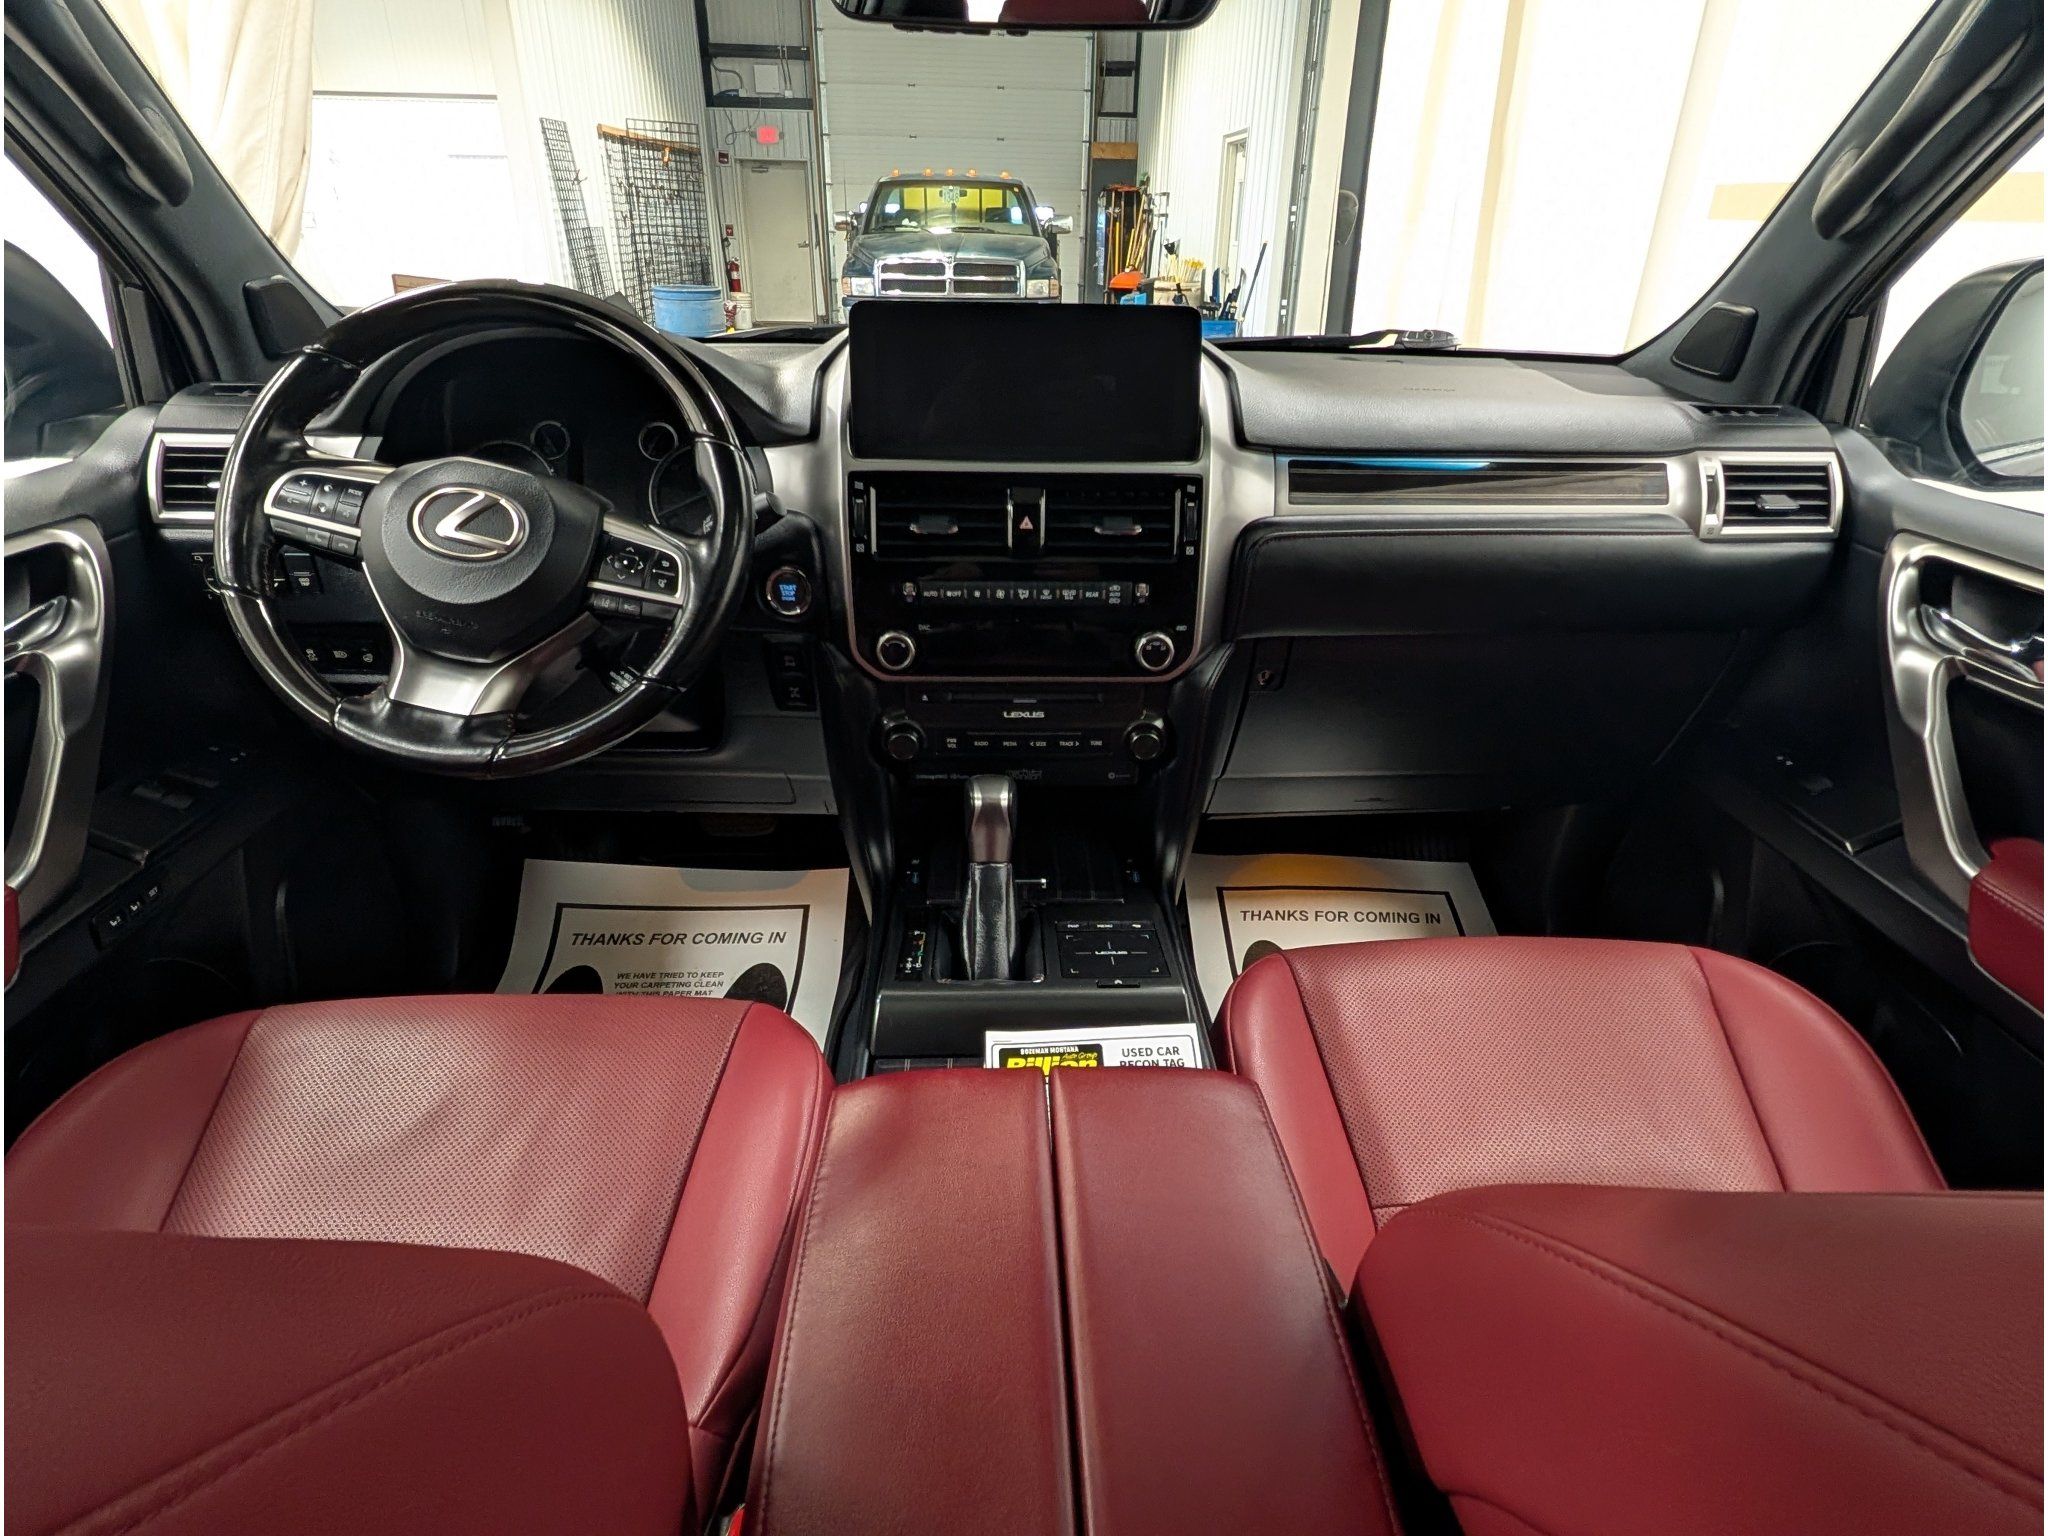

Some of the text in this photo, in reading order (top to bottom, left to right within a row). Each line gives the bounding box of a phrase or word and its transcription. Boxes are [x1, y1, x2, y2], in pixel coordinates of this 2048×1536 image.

[1002, 711, 1045, 719] LEXUS
[1240, 909, 1441, 925] THANKS FOR COMING IN
[570, 931, 787, 946] THANKS FOR COMING IN
[617, 972, 632, 980] WE
[1050, 1046, 1079, 1054] MONTANA
[1121, 1046, 1180, 1058] USED CAR
[1120, 1058, 1185, 1068] RECON TAG
